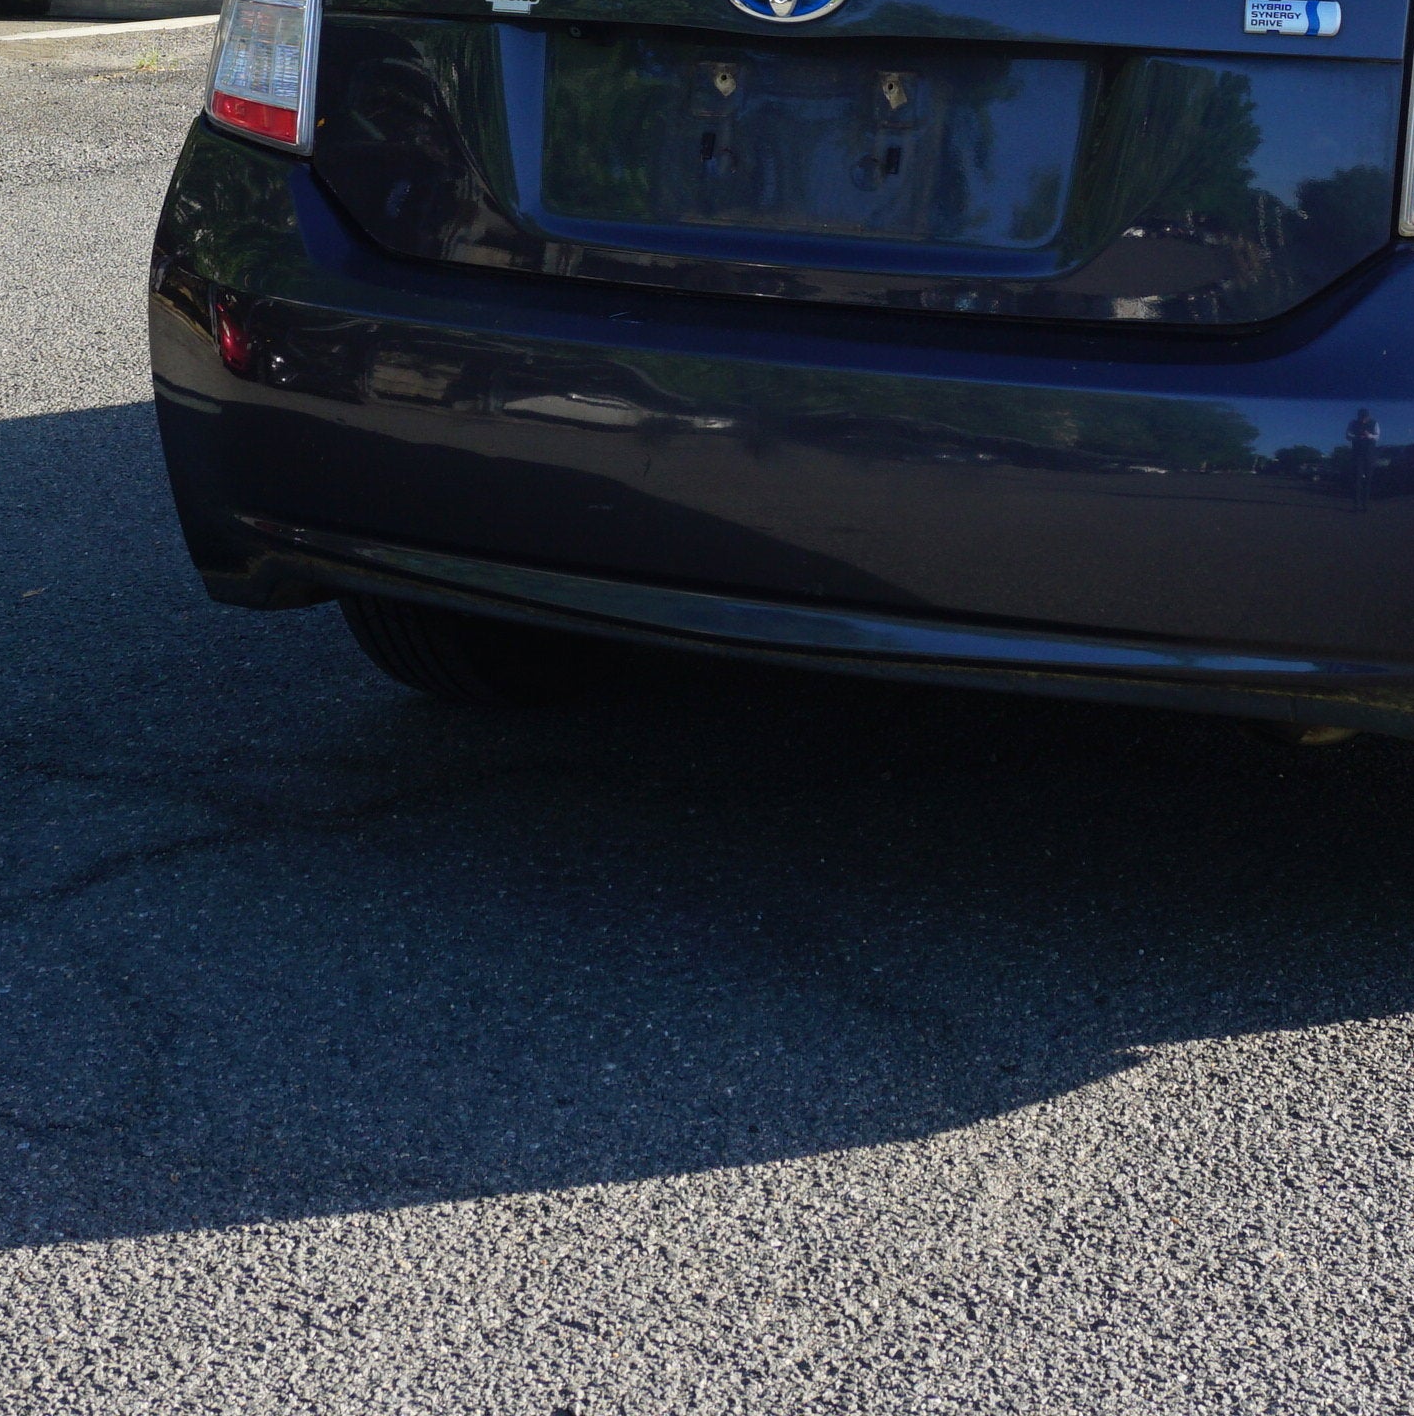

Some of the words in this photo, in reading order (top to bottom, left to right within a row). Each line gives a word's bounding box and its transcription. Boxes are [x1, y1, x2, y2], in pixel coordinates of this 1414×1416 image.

[1252, 3, 1292, 11] HYBRID
[1251, 11, 1301, 20] SYNERGY
[1251, 19, 1283, 27] DRIVE
